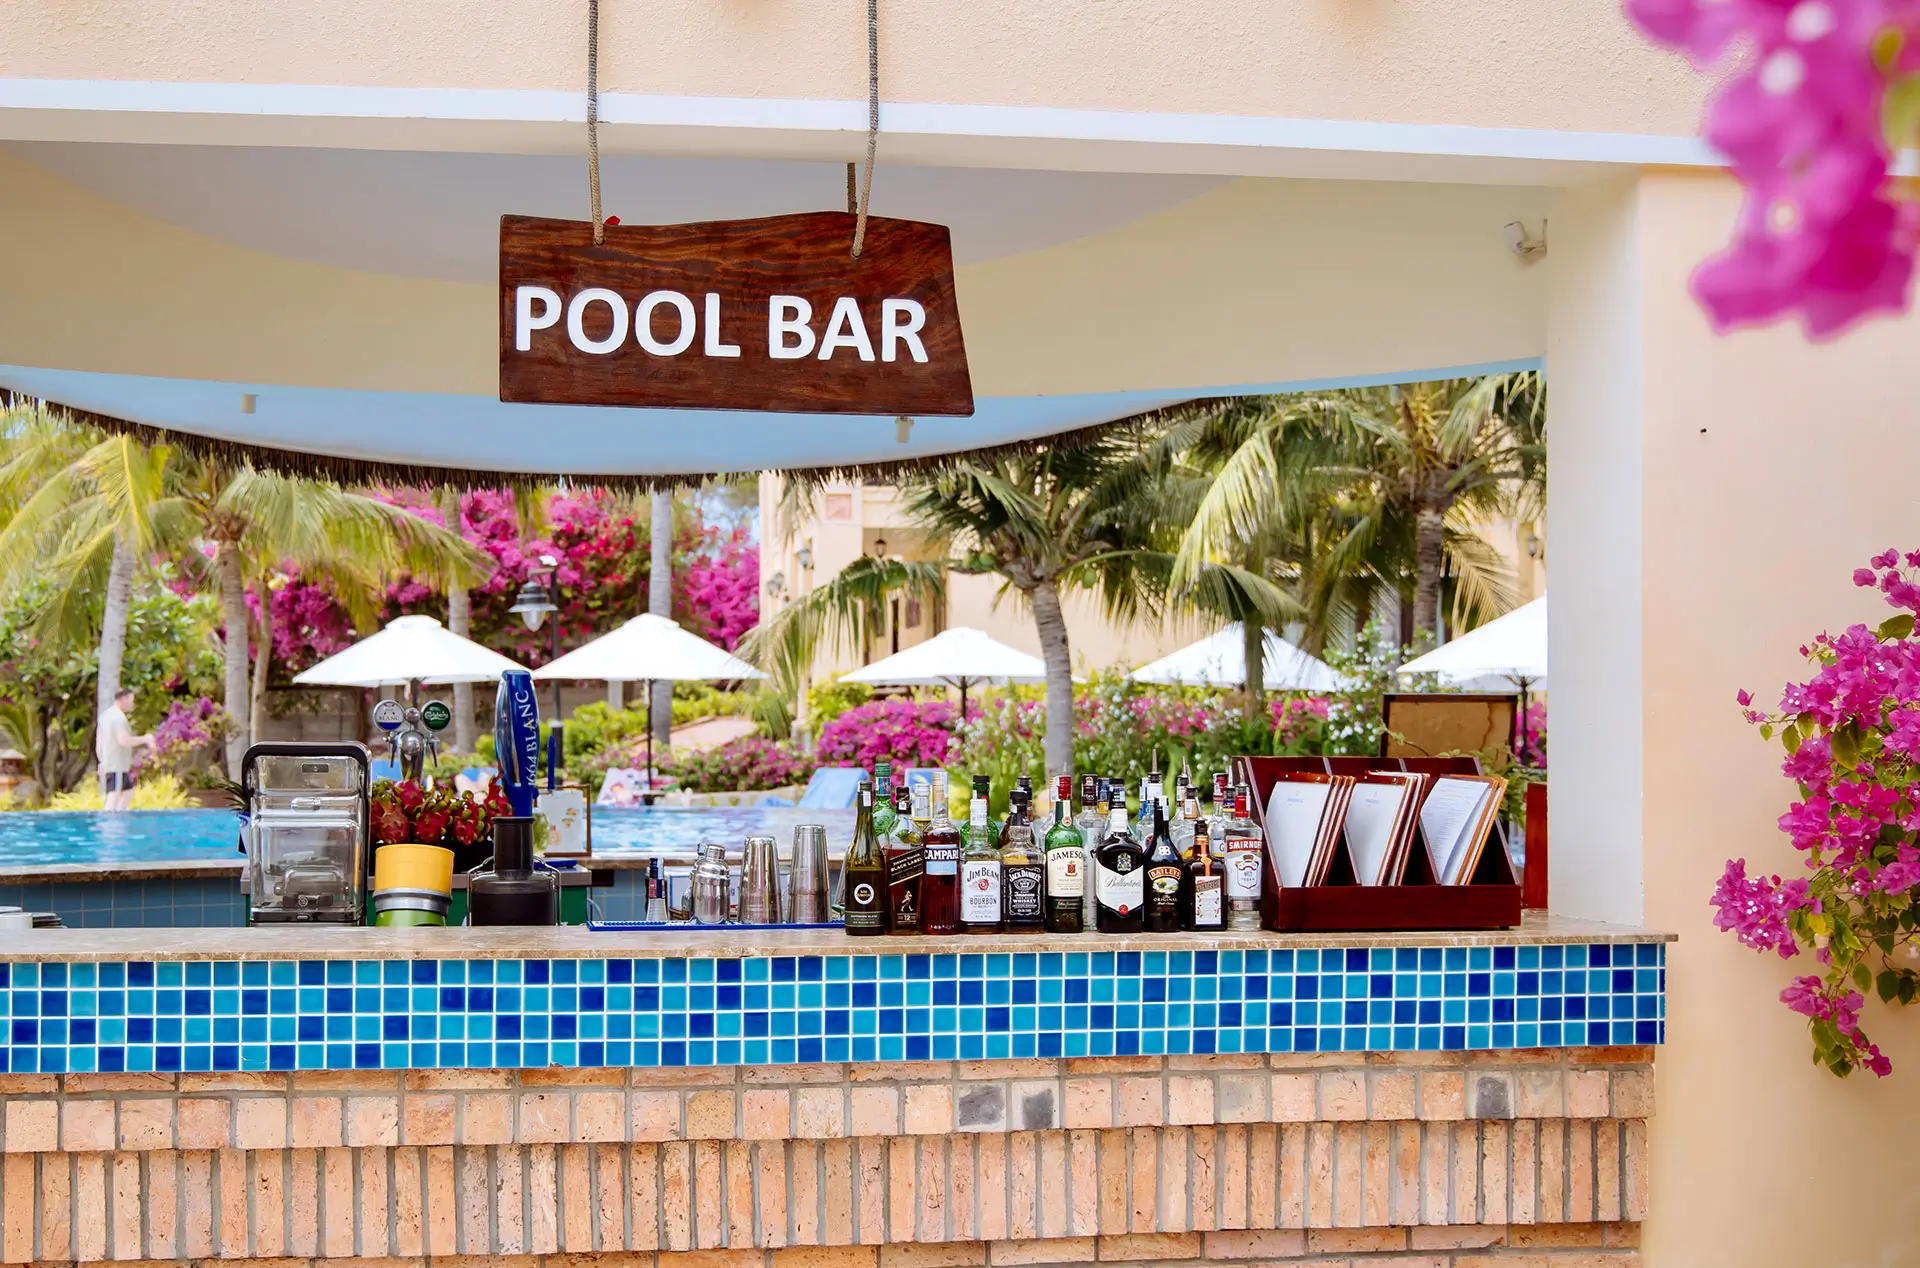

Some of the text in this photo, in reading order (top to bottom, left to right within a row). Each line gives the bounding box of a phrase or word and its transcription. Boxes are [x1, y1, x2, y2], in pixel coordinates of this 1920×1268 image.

[515, 286, 929, 363] POOL BAR
[515, 690, 538, 787] 1664 BLANC
[924, 849, 959, 860] CAMPARI
[1051, 850, 1084, 861] JAMESO
[891, 858, 923, 872] BLACK LABEL
[967, 867, 999, 882] JIM BEAM
[1009, 873, 1021, 882] JACK
[1151, 868, 1180, 878] BAILEYS
[970, 897, 997, 905] BOURBON
